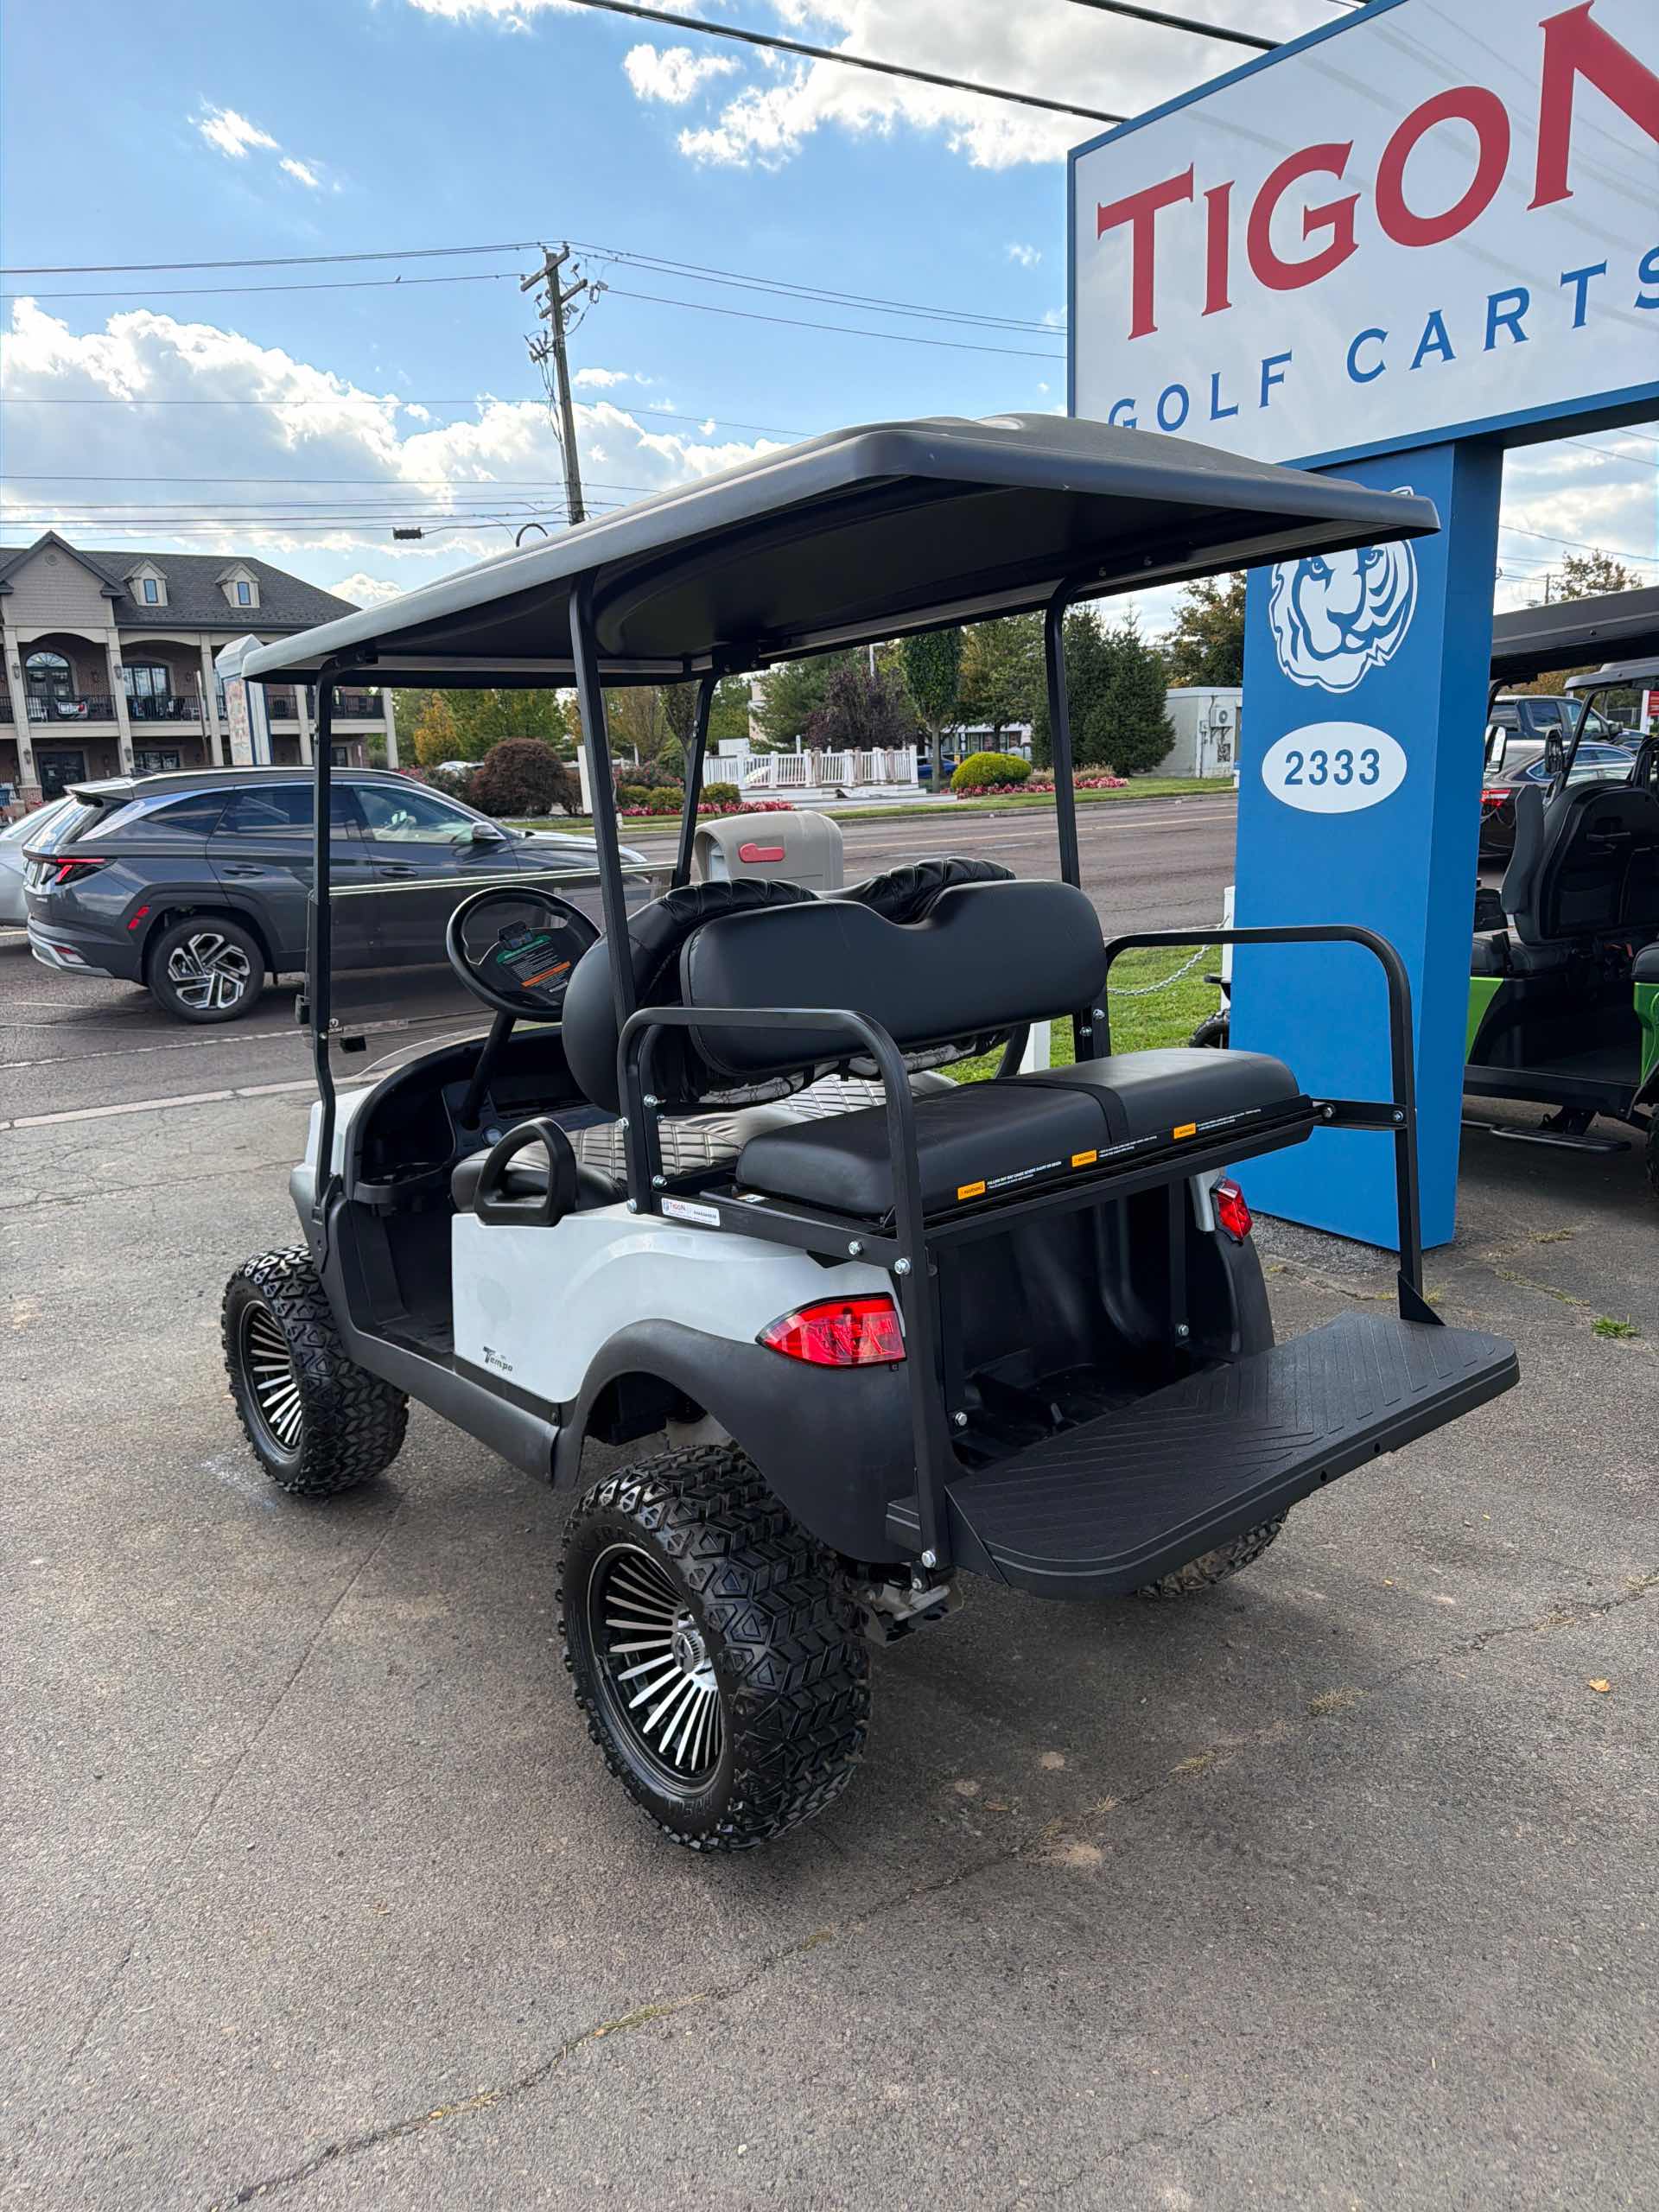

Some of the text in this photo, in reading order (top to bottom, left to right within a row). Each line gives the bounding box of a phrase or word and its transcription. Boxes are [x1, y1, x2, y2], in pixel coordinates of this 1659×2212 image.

[1097, 0, 1659, 340] TIGON
[1108, 348, 1293, 431] GOLF
[1284, 747, 1381, 786] 2333
[483, 1345, 513, 1372] Tempo
